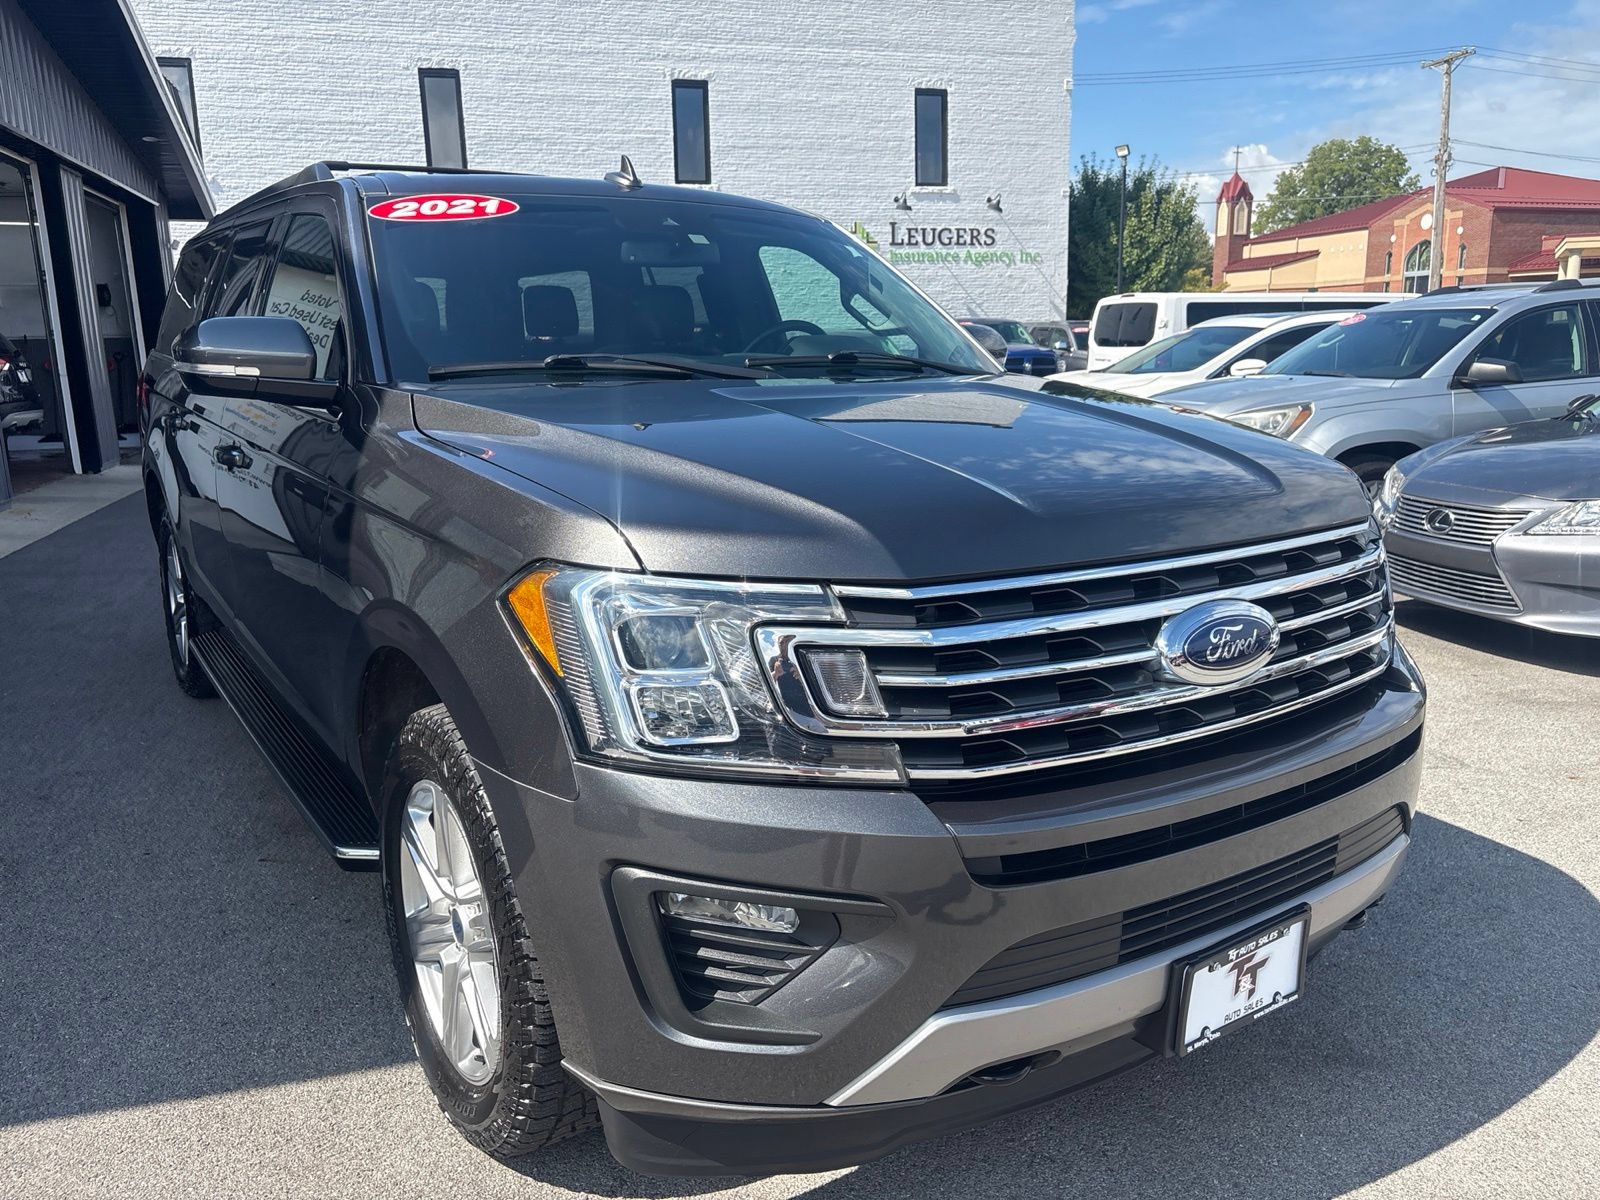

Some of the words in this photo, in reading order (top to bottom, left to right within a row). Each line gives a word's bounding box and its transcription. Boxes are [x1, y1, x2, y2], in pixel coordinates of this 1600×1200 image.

[388, 198, 502, 218] 2021
[889, 249, 960, 264] Insurance
[1206, 624, 1259, 662] Ford
[1238, 941, 1256, 956] AUTO
[1258, 931, 1278, 946] SALES
[1224, 1009, 1241, 1024] AUTO
[1243, 997, 1265, 1017] SALES
